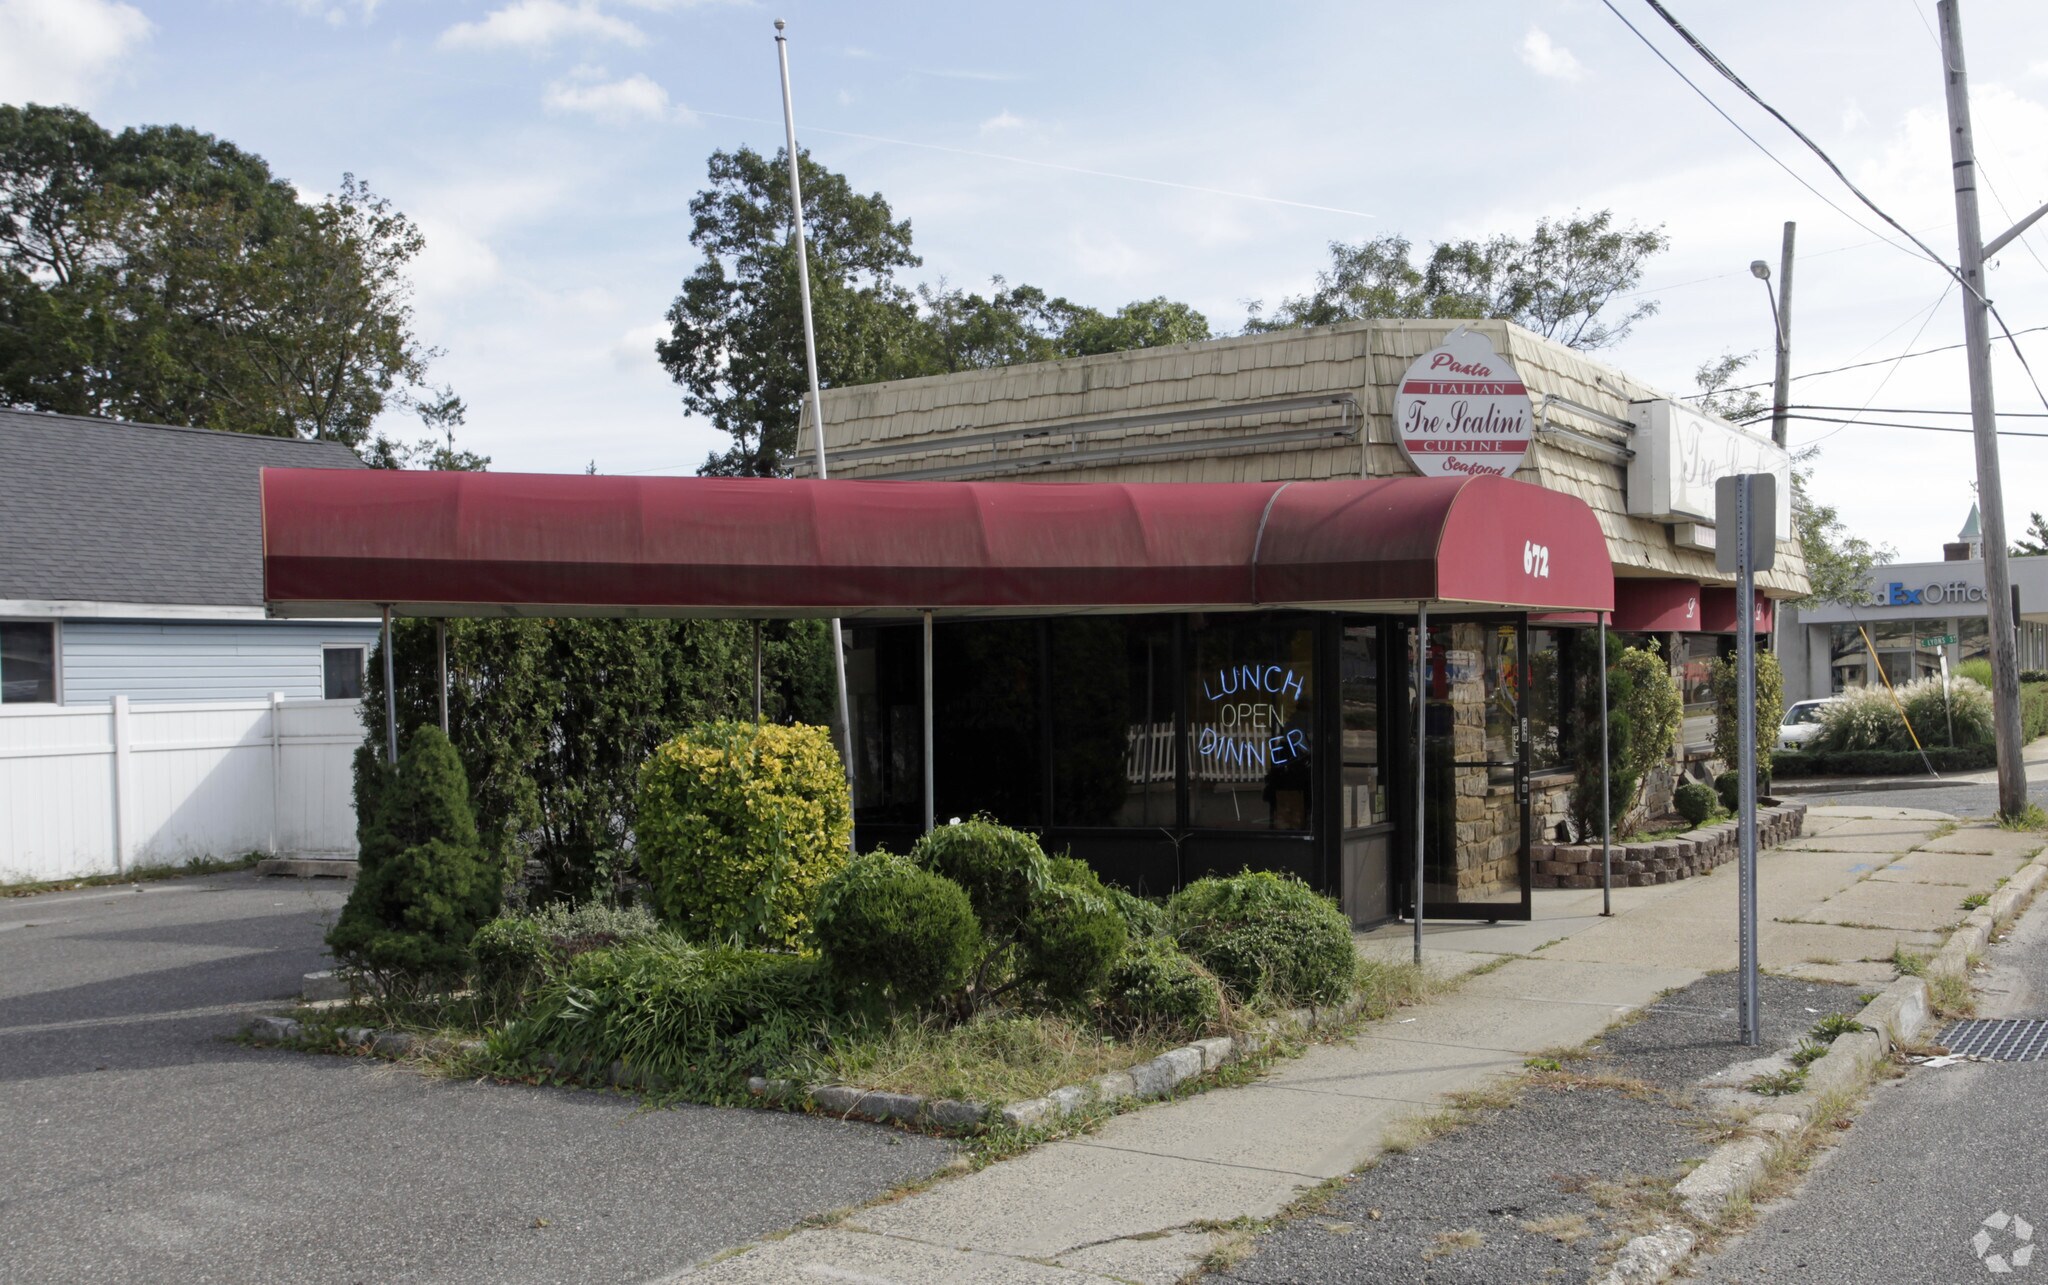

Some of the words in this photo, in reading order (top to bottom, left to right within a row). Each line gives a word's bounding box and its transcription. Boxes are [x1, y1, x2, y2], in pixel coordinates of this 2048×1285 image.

[1430, 352, 1493, 378] Pasta
[1429, 383, 1506, 395] ITALIAN
[1405, 399, 1443, 434] Tre
[1446, 400, 1527, 434] Scalini
[1423, 440, 1503, 452] CUISINE
[1442, 455, 1506, 476] Seafood
[1523, 539, 1549, 579] 672
[1927, 637, 1946, 646] LYONS
[1203, 664, 1304, 701] LUNCH
[1221, 703, 1285, 728] OPEN
[1198, 727, 1309, 767] DINNER
